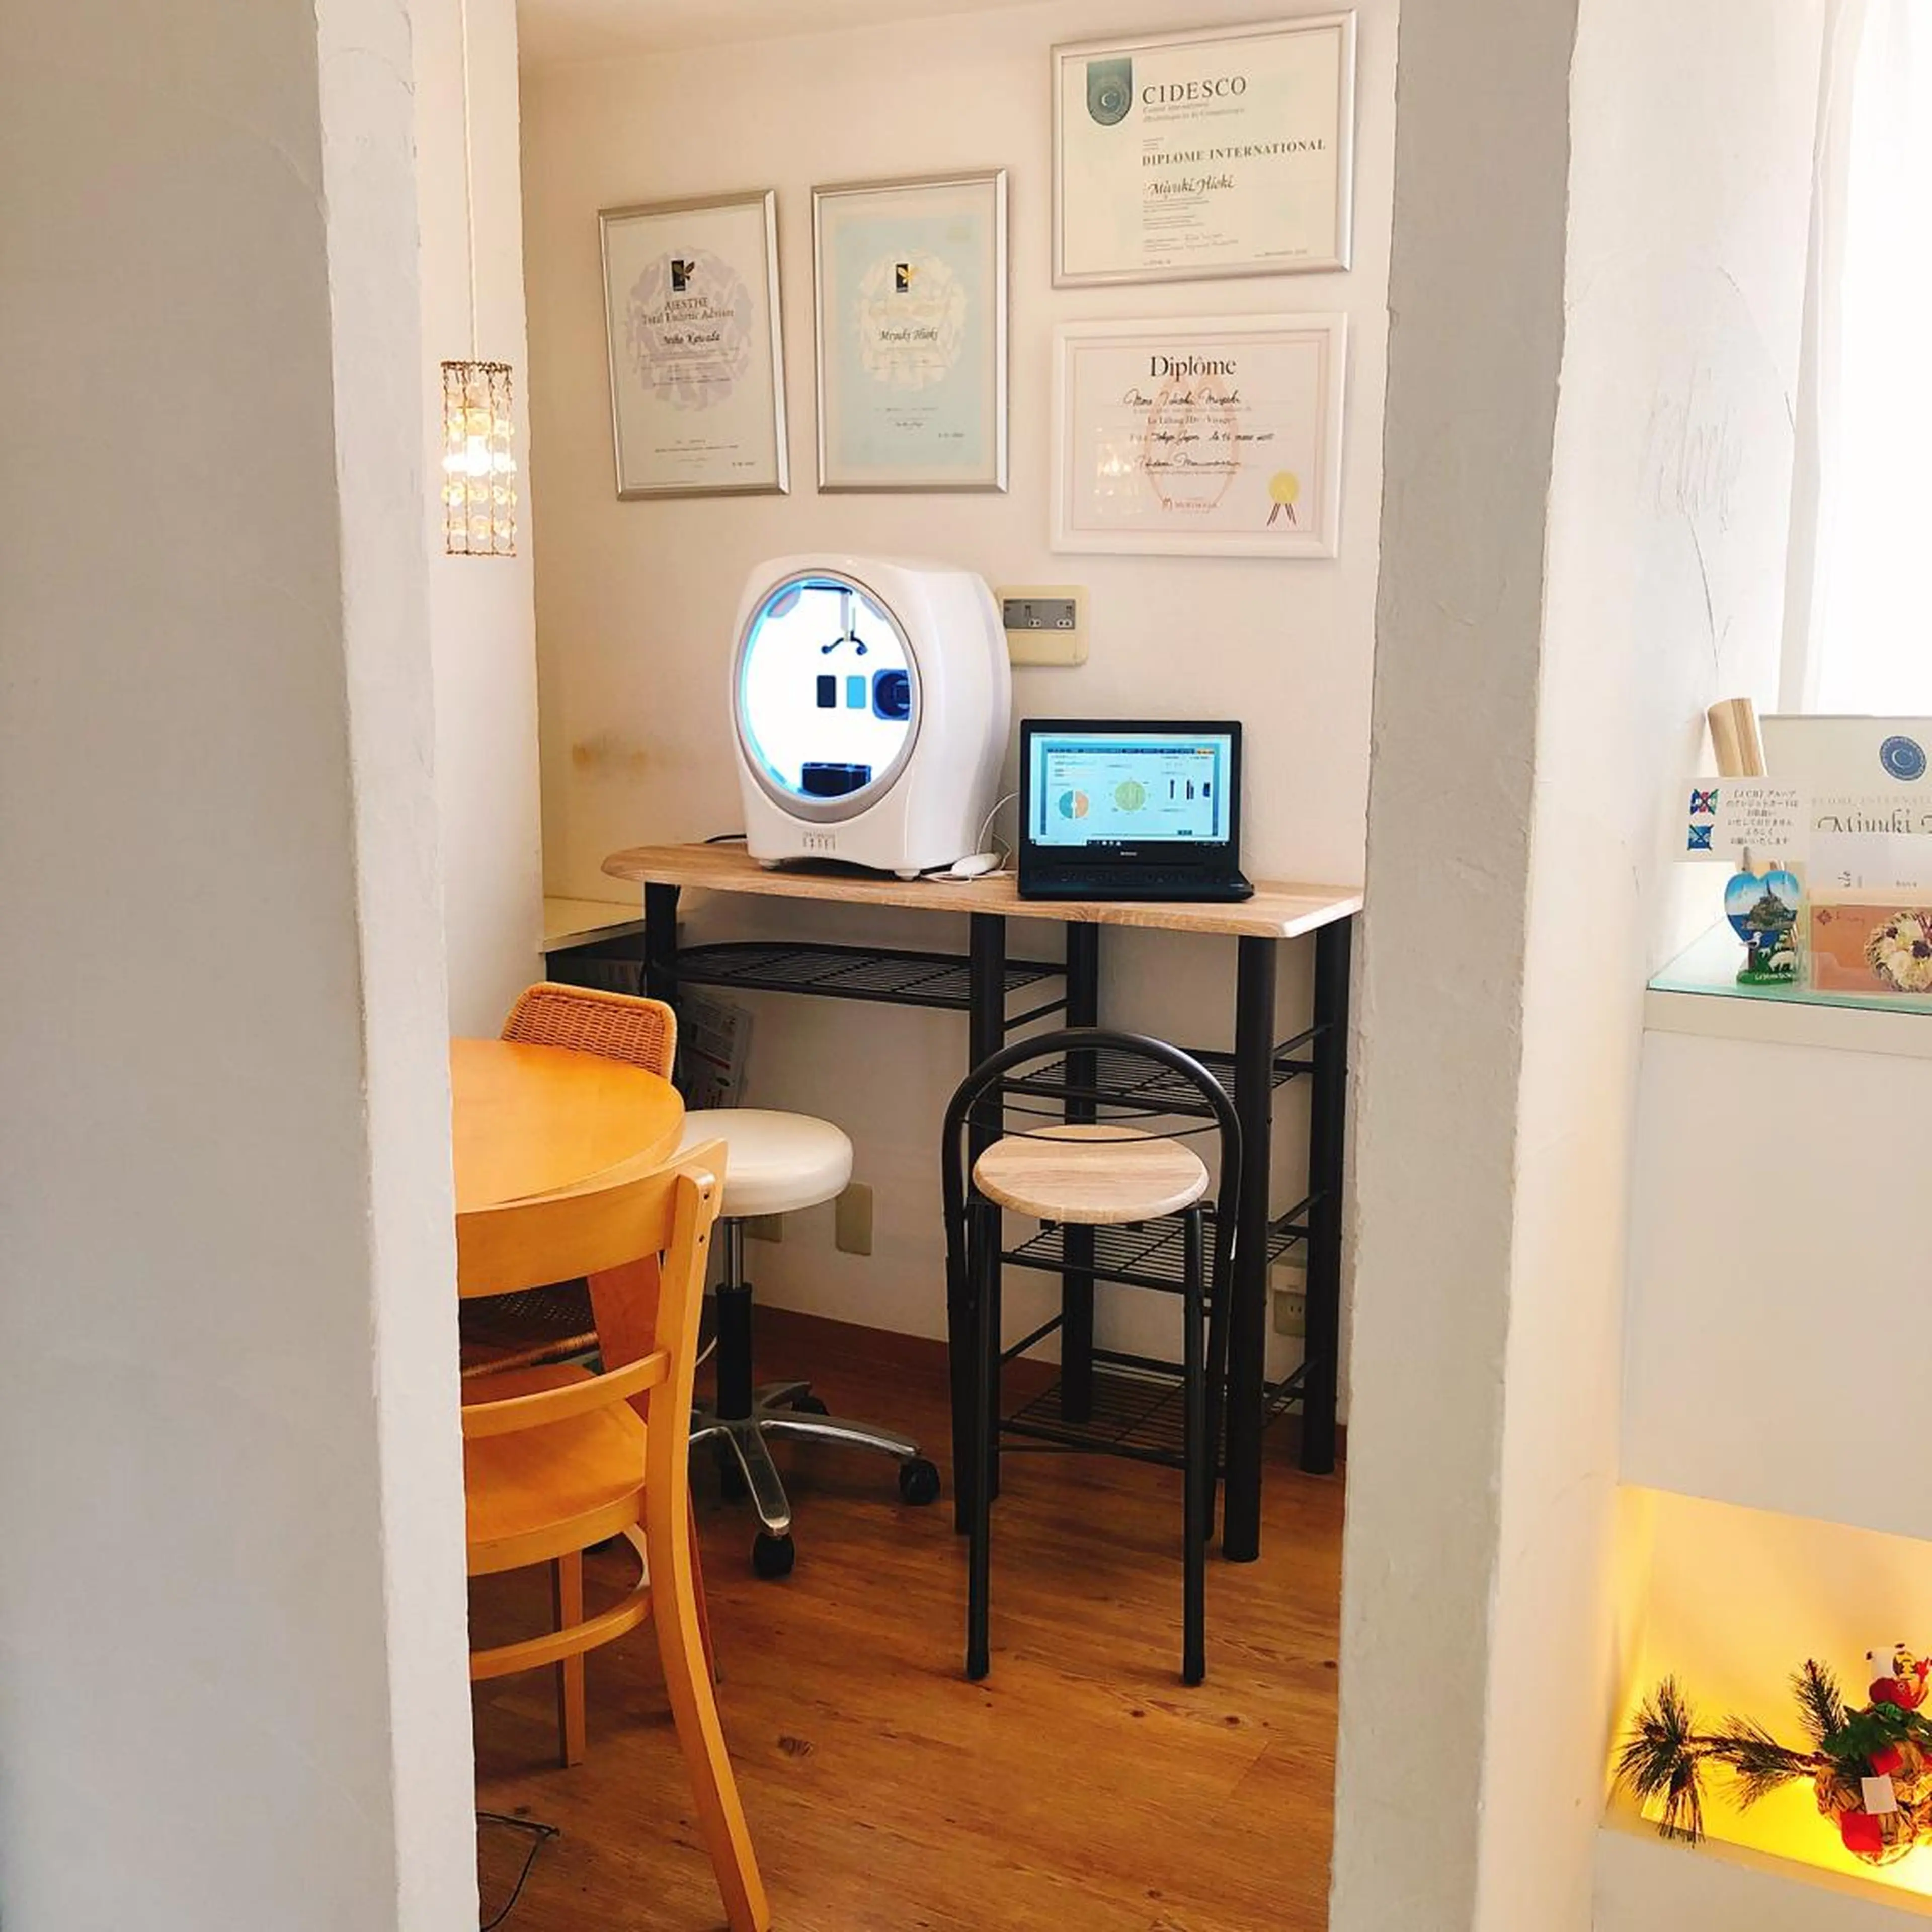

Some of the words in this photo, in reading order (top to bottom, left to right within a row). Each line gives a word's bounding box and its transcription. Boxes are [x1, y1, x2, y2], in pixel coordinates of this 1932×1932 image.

[1142, 76, 1246, 104] CIDESCO
[1142, 150, 1202, 167] DIPLOME
[1209, 138, 1326, 160] INTERNATIONAL
[1151, 355, 1236, 382] Diplôme
